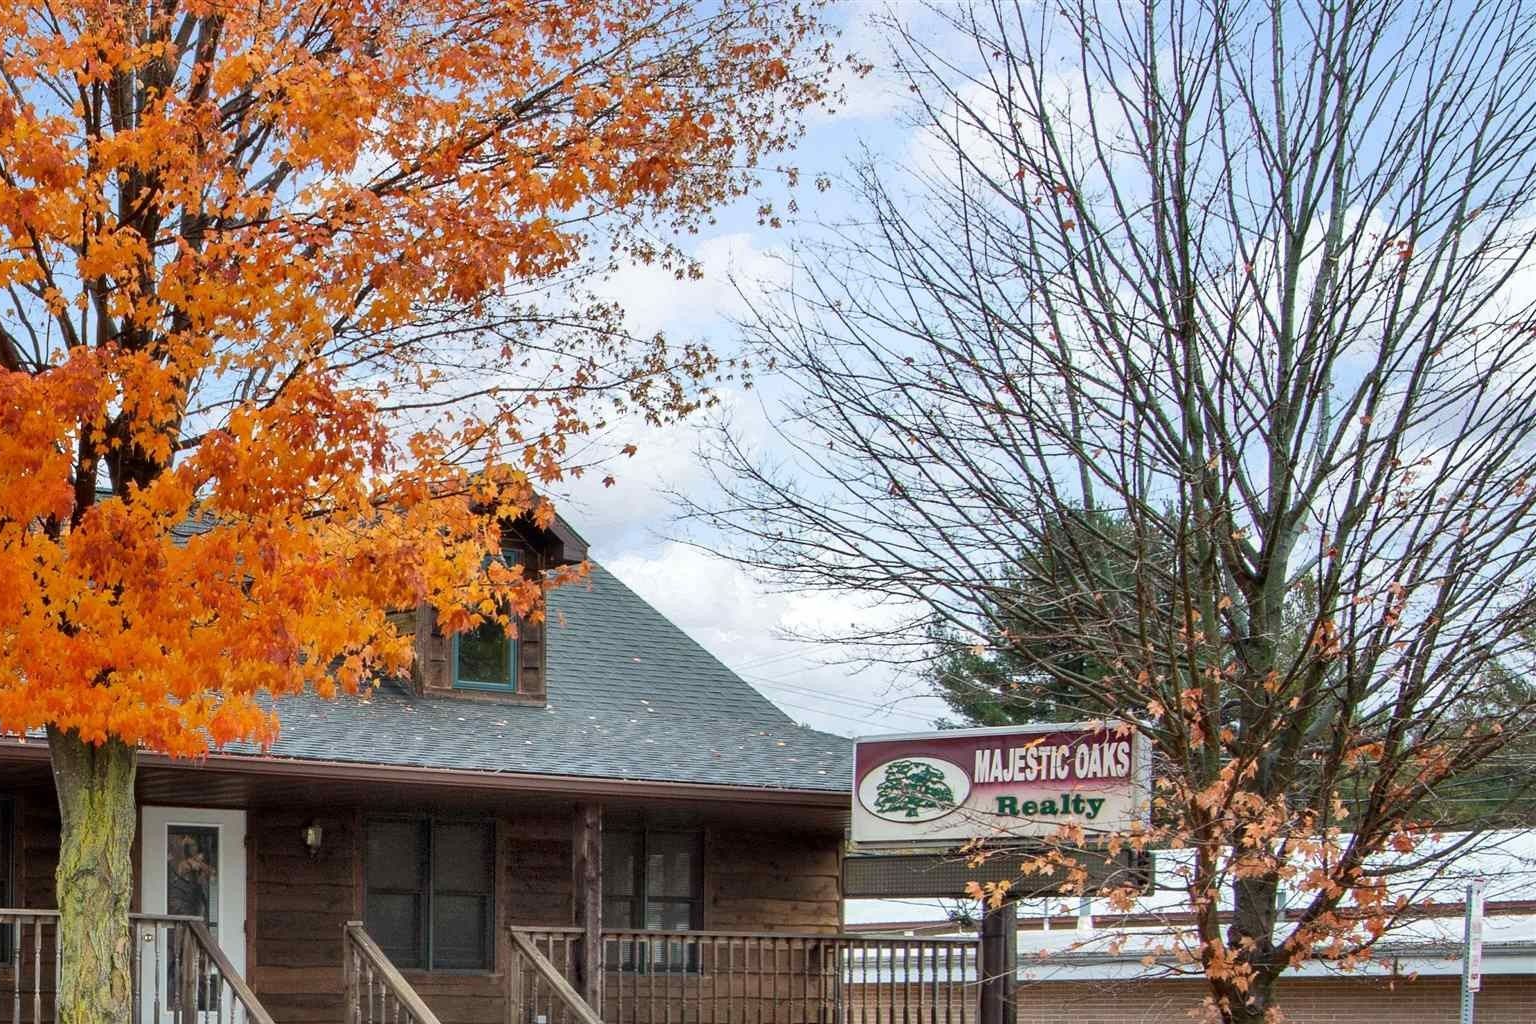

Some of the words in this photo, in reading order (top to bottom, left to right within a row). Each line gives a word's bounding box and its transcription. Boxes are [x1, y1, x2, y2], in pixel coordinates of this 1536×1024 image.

[974, 745, 1069, 783] MAJESTIC
[1075, 742, 1130, 779] OAKS
[995, 793, 1106, 819] Realty
